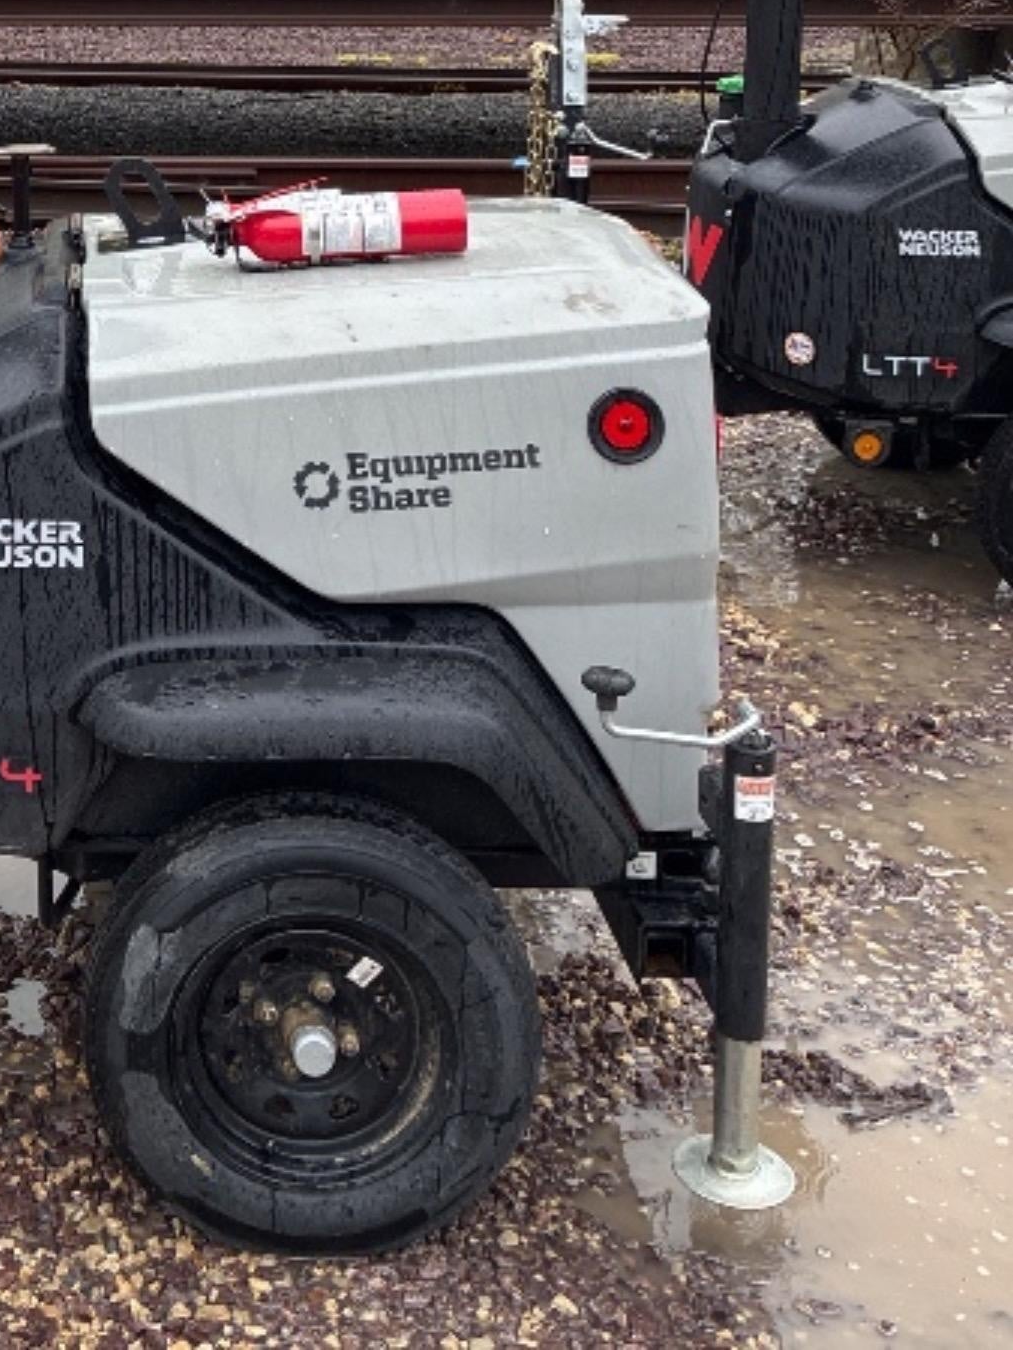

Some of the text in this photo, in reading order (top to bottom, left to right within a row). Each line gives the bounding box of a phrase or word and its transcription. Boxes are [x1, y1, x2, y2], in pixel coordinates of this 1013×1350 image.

[899, 228, 980, 244] WACKER
[899, 242, 981, 257] NEUSON
[862, 353, 958, 379] LTT4
[345, 443, 542, 484] Equipment
[348, 484, 453, 513] Share
